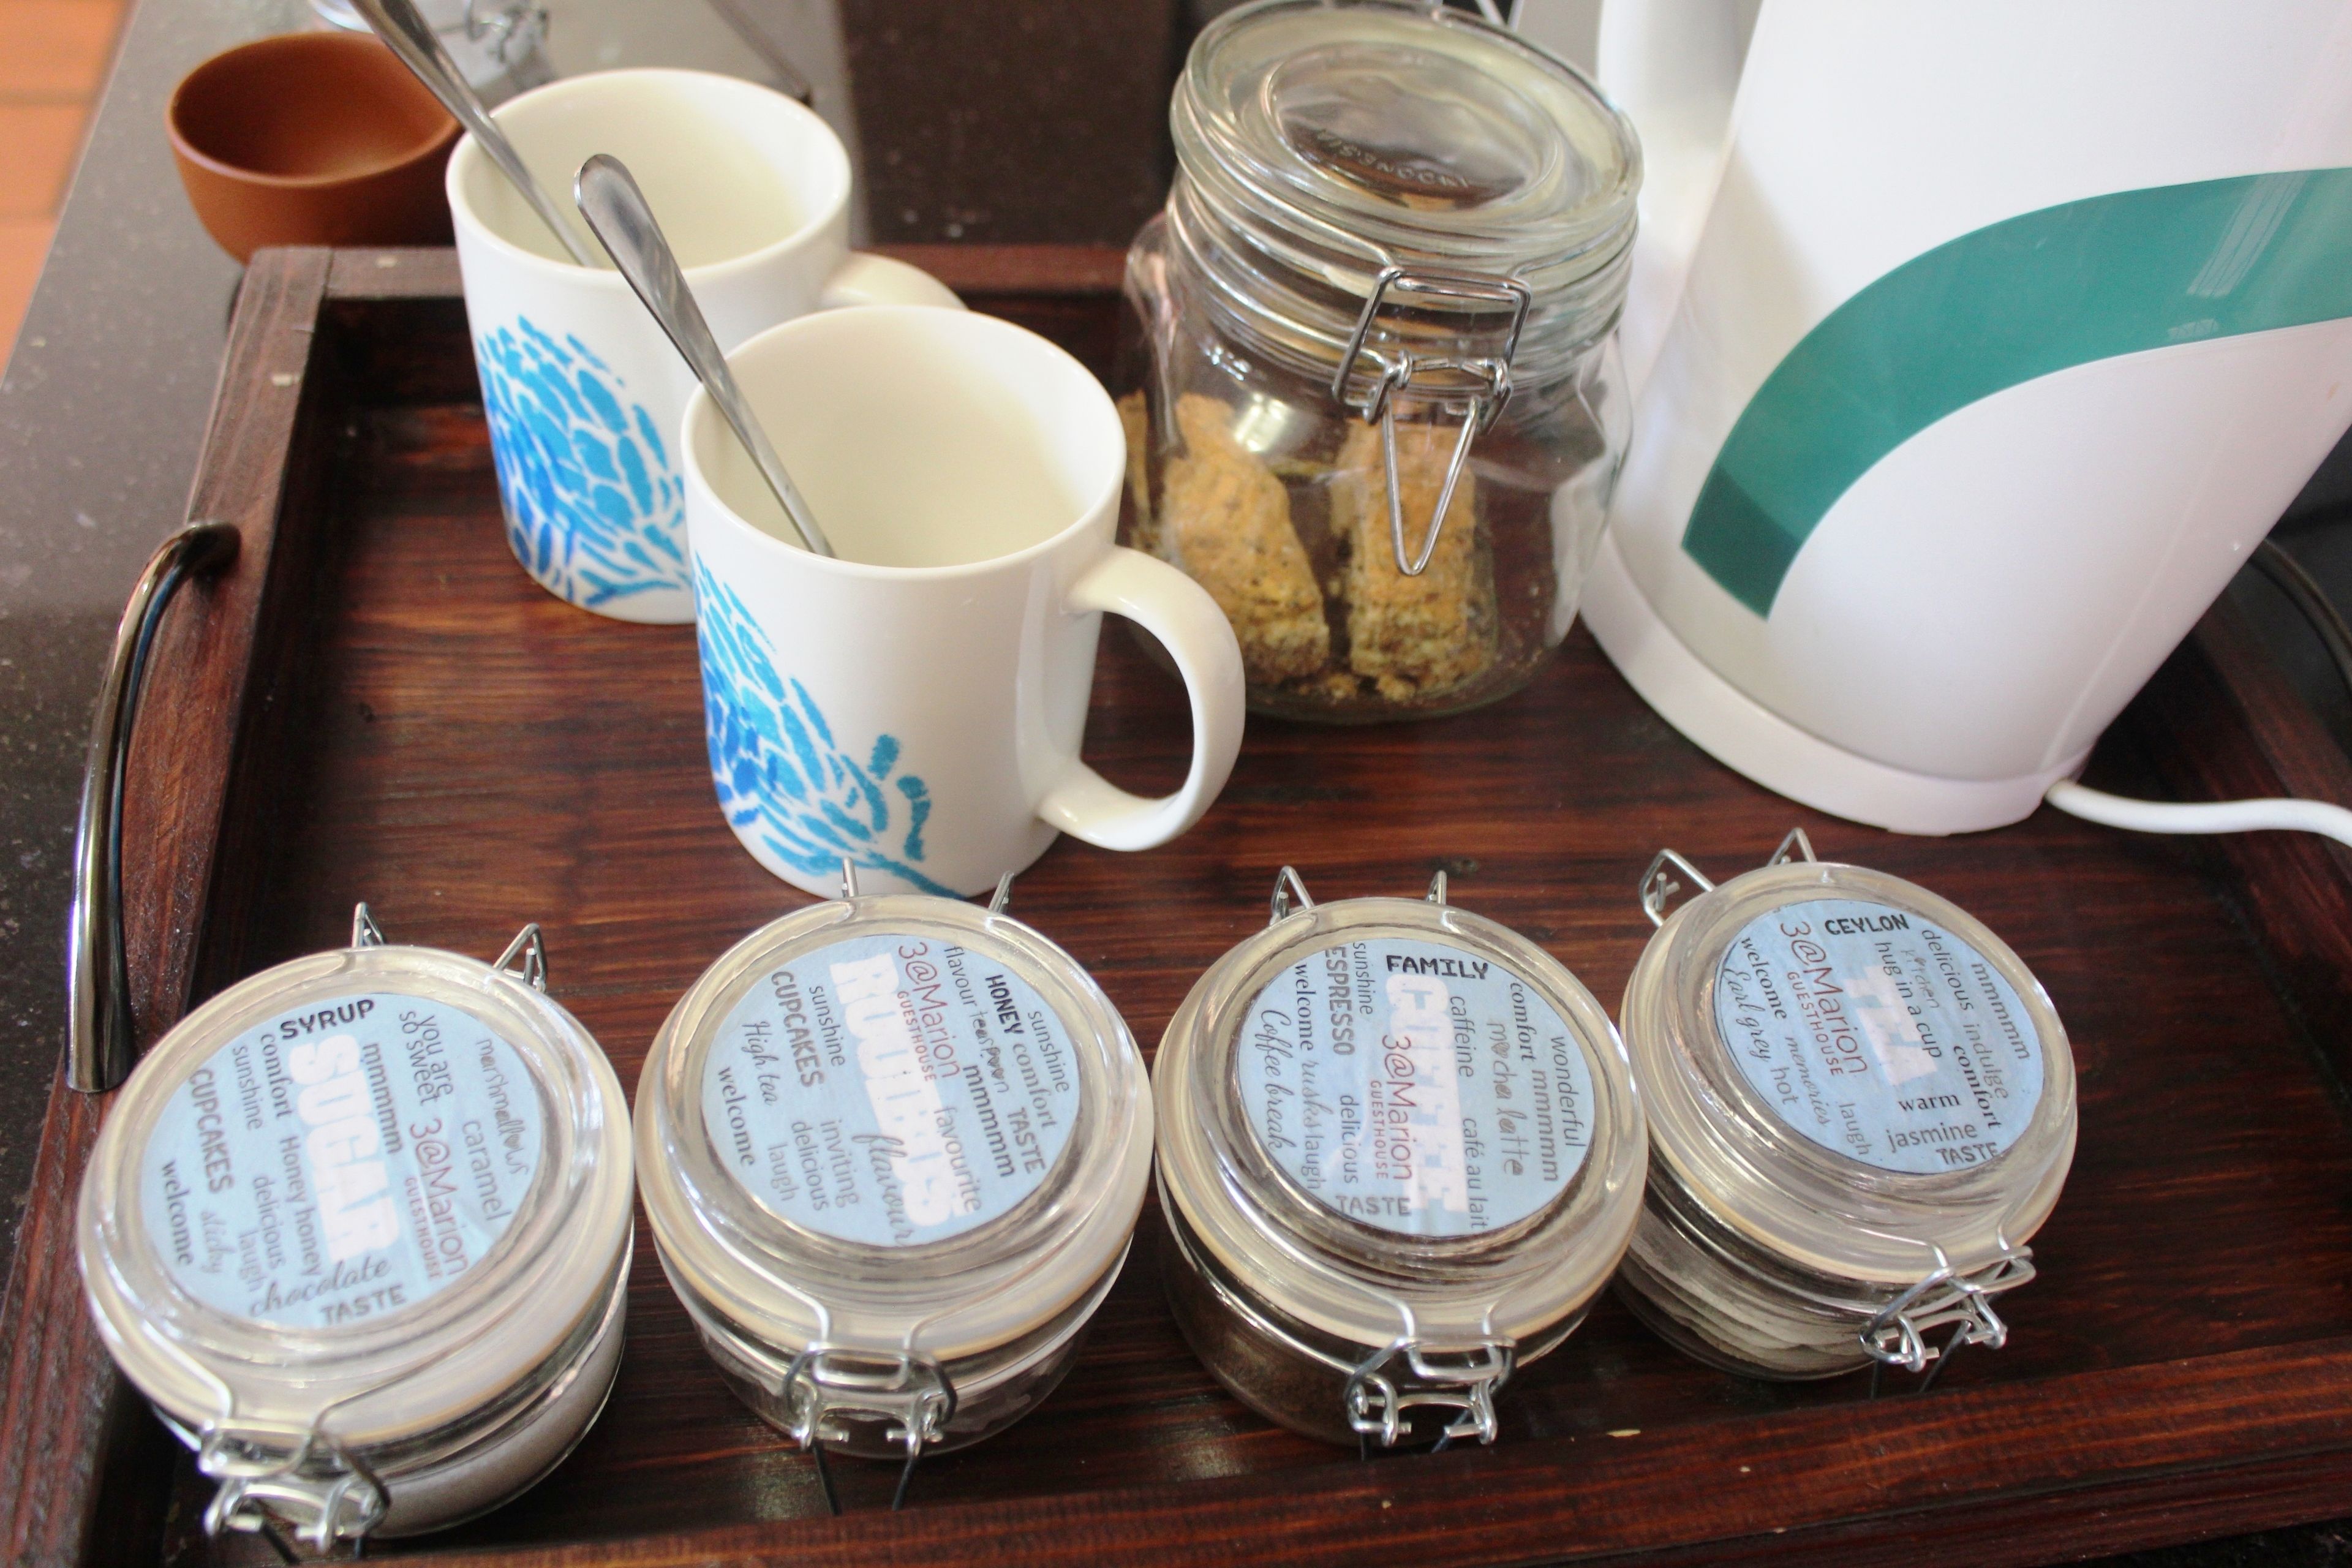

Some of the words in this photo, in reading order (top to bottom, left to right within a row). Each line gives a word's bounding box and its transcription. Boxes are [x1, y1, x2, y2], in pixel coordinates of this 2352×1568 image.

[1825, 914, 1910, 935] CEYLON
[943, 946, 978, 1008] flavour
[1295, 963, 1315, 1052] welcome
[1324, 946, 1355, 1055] ESPRESSO
[1353, 942, 1373, 1015] sunshine
[1386, 954, 1488, 979] FAMILY
[1724, 968, 1765, 1012] Earl
[1741, 937, 1787, 1019] welcome
[1781, 922, 1868, 1073] 3@Marion
[1875, 942, 1902, 975] hug
[1896, 982, 1913, 997] in
[1908, 1006, 1921, 1016] a
[1917, 1022, 1941, 1058] cup
[1923, 929, 1973, 1010] delicious
[280, 998, 375, 1039] SYRUP
[399, 1011, 420, 1034] so
[742, 1022, 778, 1072] High
[771, 971, 824, 1088] CUPCAKES
[809, 986, 845, 1066] sunshine
[898, 990, 937, 1082] GUESTHOUSE
[899, 942, 960, 1078] 3@Marion
[1255, 1009, 1291, 1077] Coffee
[1450, 996, 1475, 1077] caffeine
[1510, 982, 1536, 1061] comfort
[1737, 1011, 1771, 1061] grey
[1787, 971, 1843, 1076] GUESTHOUSE
[1844, 965, 1937, 1084] TEA
[1972, 963, 2030, 1060] mmmmm
[233, 1045, 263, 1130] sunshine
[261, 1033, 292, 1119] comfort
[406, 1038, 440, 1106] sweet
[415, 1014, 442, 1057] you
[431, 1059, 453, 1096] are
[759, 1074, 778, 1107] tea
[985, 974, 1024, 1035] HONEY
[1013, 1042, 1057, 1129] comfort
[1028, 1010, 1069, 1093] sunshine
[1551, 1036, 1585, 1147] wonderful
[1771, 1067, 1798, 1104] hot
[1785, 1037, 1831, 1126] memories
[1954, 1046, 2001, 1128] comfort
[1964, 1024, 2008, 1099] indulge
[190, 1069, 233, 1193] CUPCAKES
[363, 1042, 402, 1153] mmmmm
[718, 1066, 755, 1166] welcome
[964, 1065, 1015, 1177] mmmmm
[1265, 1083, 1294, 1151] break
[1301, 1060, 1333, 1130] rusks
[1370, 1080, 1388, 1180] GUESTHOUSE
[1382, 1035, 1415, 1180] 3@Marion
[1532, 1070, 1558, 1182] mmmmm
[1839, 1103, 1870, 1155] laugh
[1899, 1094, 1961, 1112] warm
[288, 1033, 400, 1264] SUGAR
[462, 1120, 512, 1221] caramel
[767, 1142, 795, 1202] laugh
[791, 1121, 828, 1212] delicious
[821, 1119, 859, 1208] inviting
[935, 1106, 979, 1212] favourite
[1007, 1107, 1045, 1174] TASTE
[1301, 1132, 1327, 1190] laugh
[1340, 1095, 1357, 1184] delicious
[1463, 1118, 1485, 1159] café
[1467, 1164, 1480, 1187] au
[1499, 1107, 1531, 1175] latte
[1888, 1123, 1977, 1153] jasmine
[1936, 1144, 1999, 1165] TASTE
[161, 1159, 193, 1265] welcome
[253, 1175, 285, 1270] delicious
[280, 1137, 306, 1203] Honey
[296, 1207, 323, 1277] honey
[405, 1177, 442, 1279] GUESTHOUSE
[410, 1118, 469, 1276] 3@Marion
[851, 1134, 913, 1248] flavour
[1335, 1196, 1411, 1216] TASTE
[1468, 1189, 1488, 1229] lait
[238, 1231, 265, 1292] laugh
[251, 1257, 391, 1317] chocolate
[320, 1284, 407, 1325] TASTE
